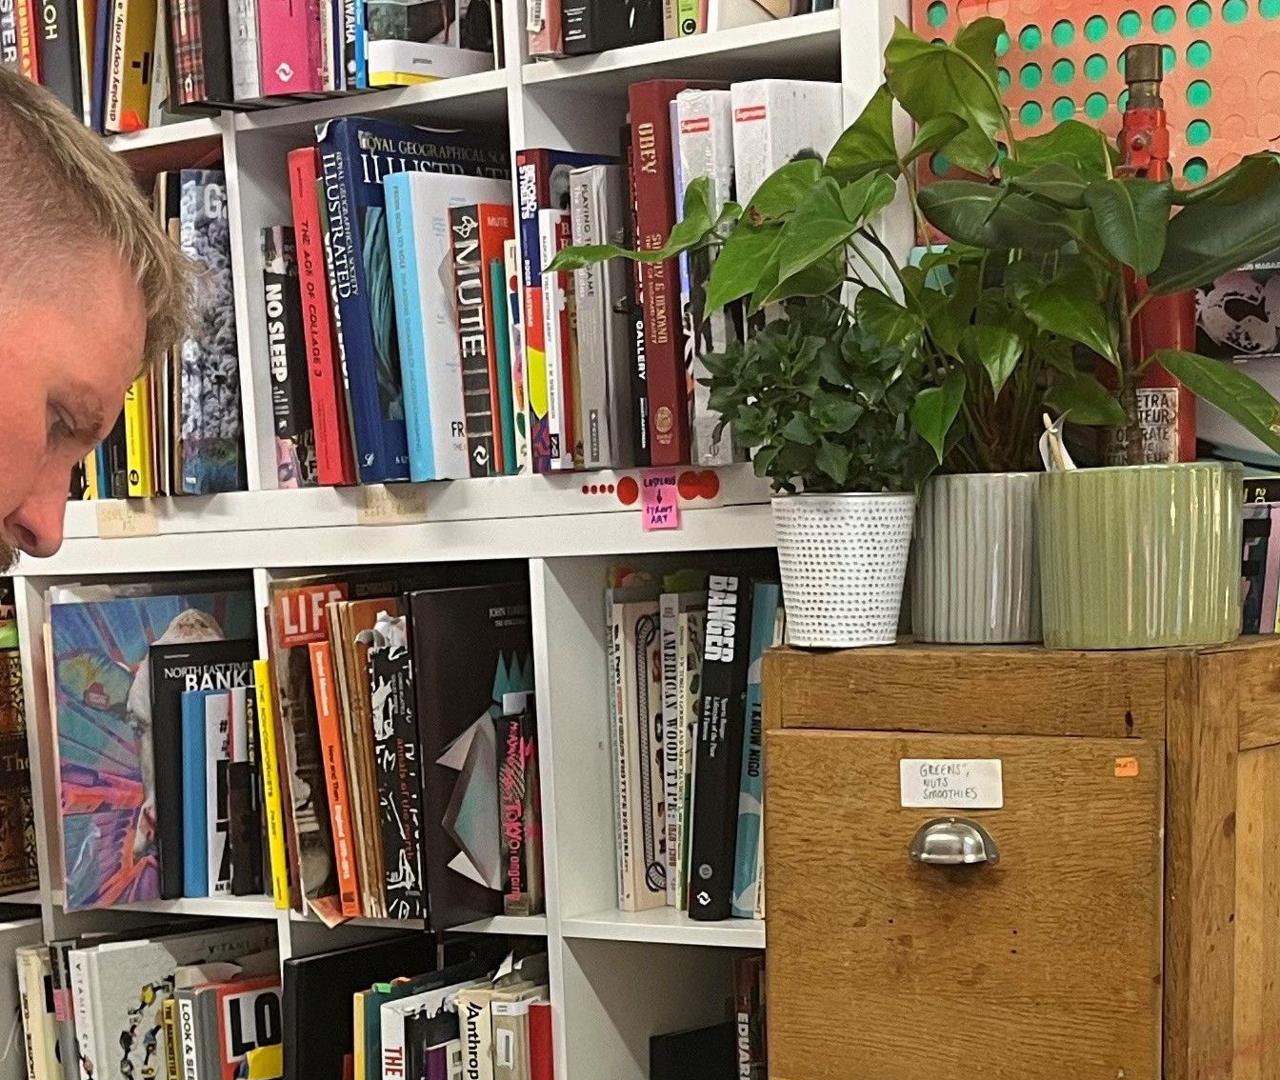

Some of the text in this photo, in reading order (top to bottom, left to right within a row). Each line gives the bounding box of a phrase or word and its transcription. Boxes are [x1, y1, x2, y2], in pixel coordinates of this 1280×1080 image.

[112, 44, 122, 76] copy
[109, 78, 119, 122] display
[398, 140, 487, 163] GEOGRAPHICAL
[638, 122, 657, 175] OBEY
[581, 183, 592, 233] PLAYING
[302, 220, 311, 245] THE
[323, 153, 352, 299] ILLUSTRATED
[304, 250, 313, 276] AGE
[306, 281, 315, 299] OF
[455, 238, 486, 358] MUTE
[266, 284, 289, 383] NO SLEEP
[309, 305, 321, 365] COLLAGE
[636, 320, 646, 380] GALLERY
[705, 575, 739, 663] BANGER
[164, 665, 202, 679] NORTH
[203, 663, 225, 676] EAST
[315, 651, 326, 677] Daniel
[663, 628, 678, 818] AMERICAN WOOD TYPE:
[749, 710, 761, 746] KNOW
[327, 745, 336, 762] Now
[747, 747, 760, 778] NIGO
[396, 737, 414, 860] annals of the north
[923, 777, 949, 788] NUTS
[923, 788, 978, 800] SMOOTHIES
[334, 804, 346, 838] England
[165, 1005, 173, 1020] THE
[182, 1004, 191, 1041] LOOK
[166, 1023, 176, 1075] MANCHESTER
[185, 1044, 193, 1055] &
[384, 1046, 403, 1077] THE
